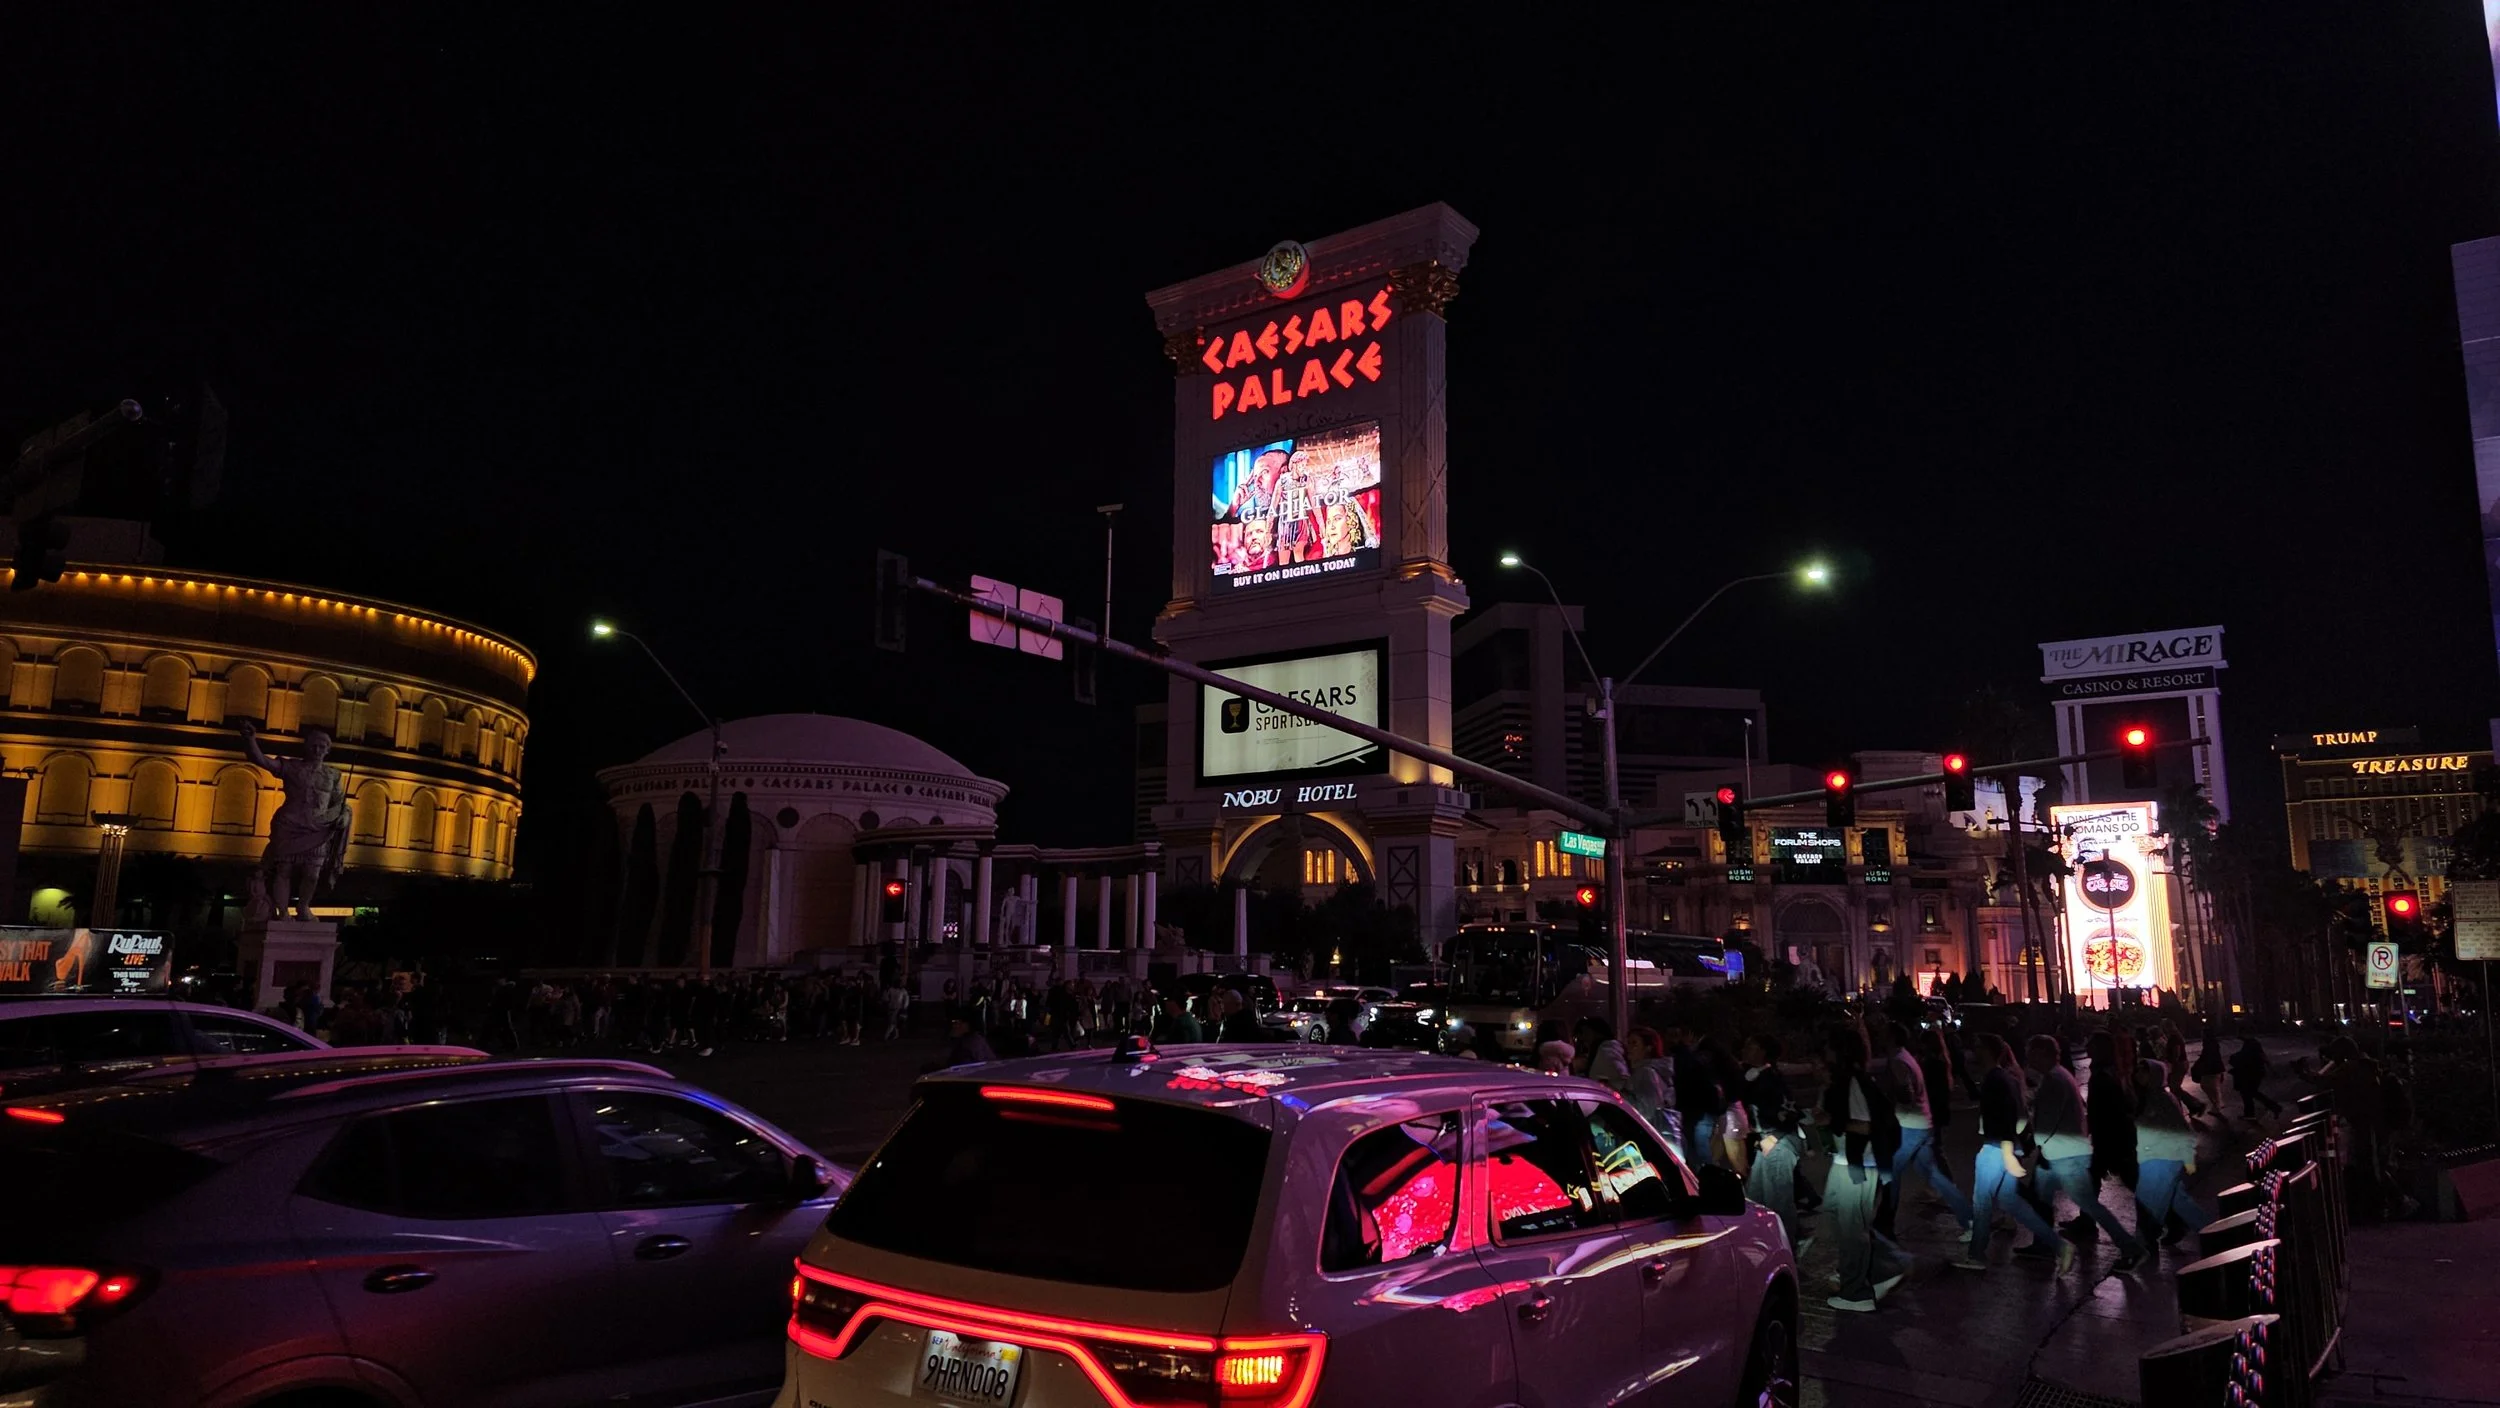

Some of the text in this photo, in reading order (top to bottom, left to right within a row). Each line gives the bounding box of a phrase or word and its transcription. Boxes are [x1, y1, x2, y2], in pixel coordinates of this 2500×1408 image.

[1202, 289, 1392, 374] CAESARS
[1213, 341, 1382, 421] PALACE
[1240, 488, 1352, 523] GLADIATOR
[1233, 557, 1356, 587] BUY IT ON DIGITAL TODAY
[2050, 634, 2213, 669] THE MIRAGE
[2062, 672, 2205, 695] CASINO & RESORT
[2313, 731, 2377, 746] TRUMP
[2352, 756, 2469, 774] TREASURE
[761, 778, 898, 794] CAESARS PALACE
[919, 787, 965, 802] CAESARS
[1222, 783, 1357, 808] NOBU HOTEL
[2075, 823, 2140, 835] OMANS DO
[1564, 831, 1577, 848] Las
[1577, 834, 1598, 856] Vegas
[1774, 838, 1842, 847] FORUM SHOPS
[19, 941, 52, 961] THAT
[123, 953, 146, 965] LIVE
[923, 1354, 1009, 1399] 9HRN008
